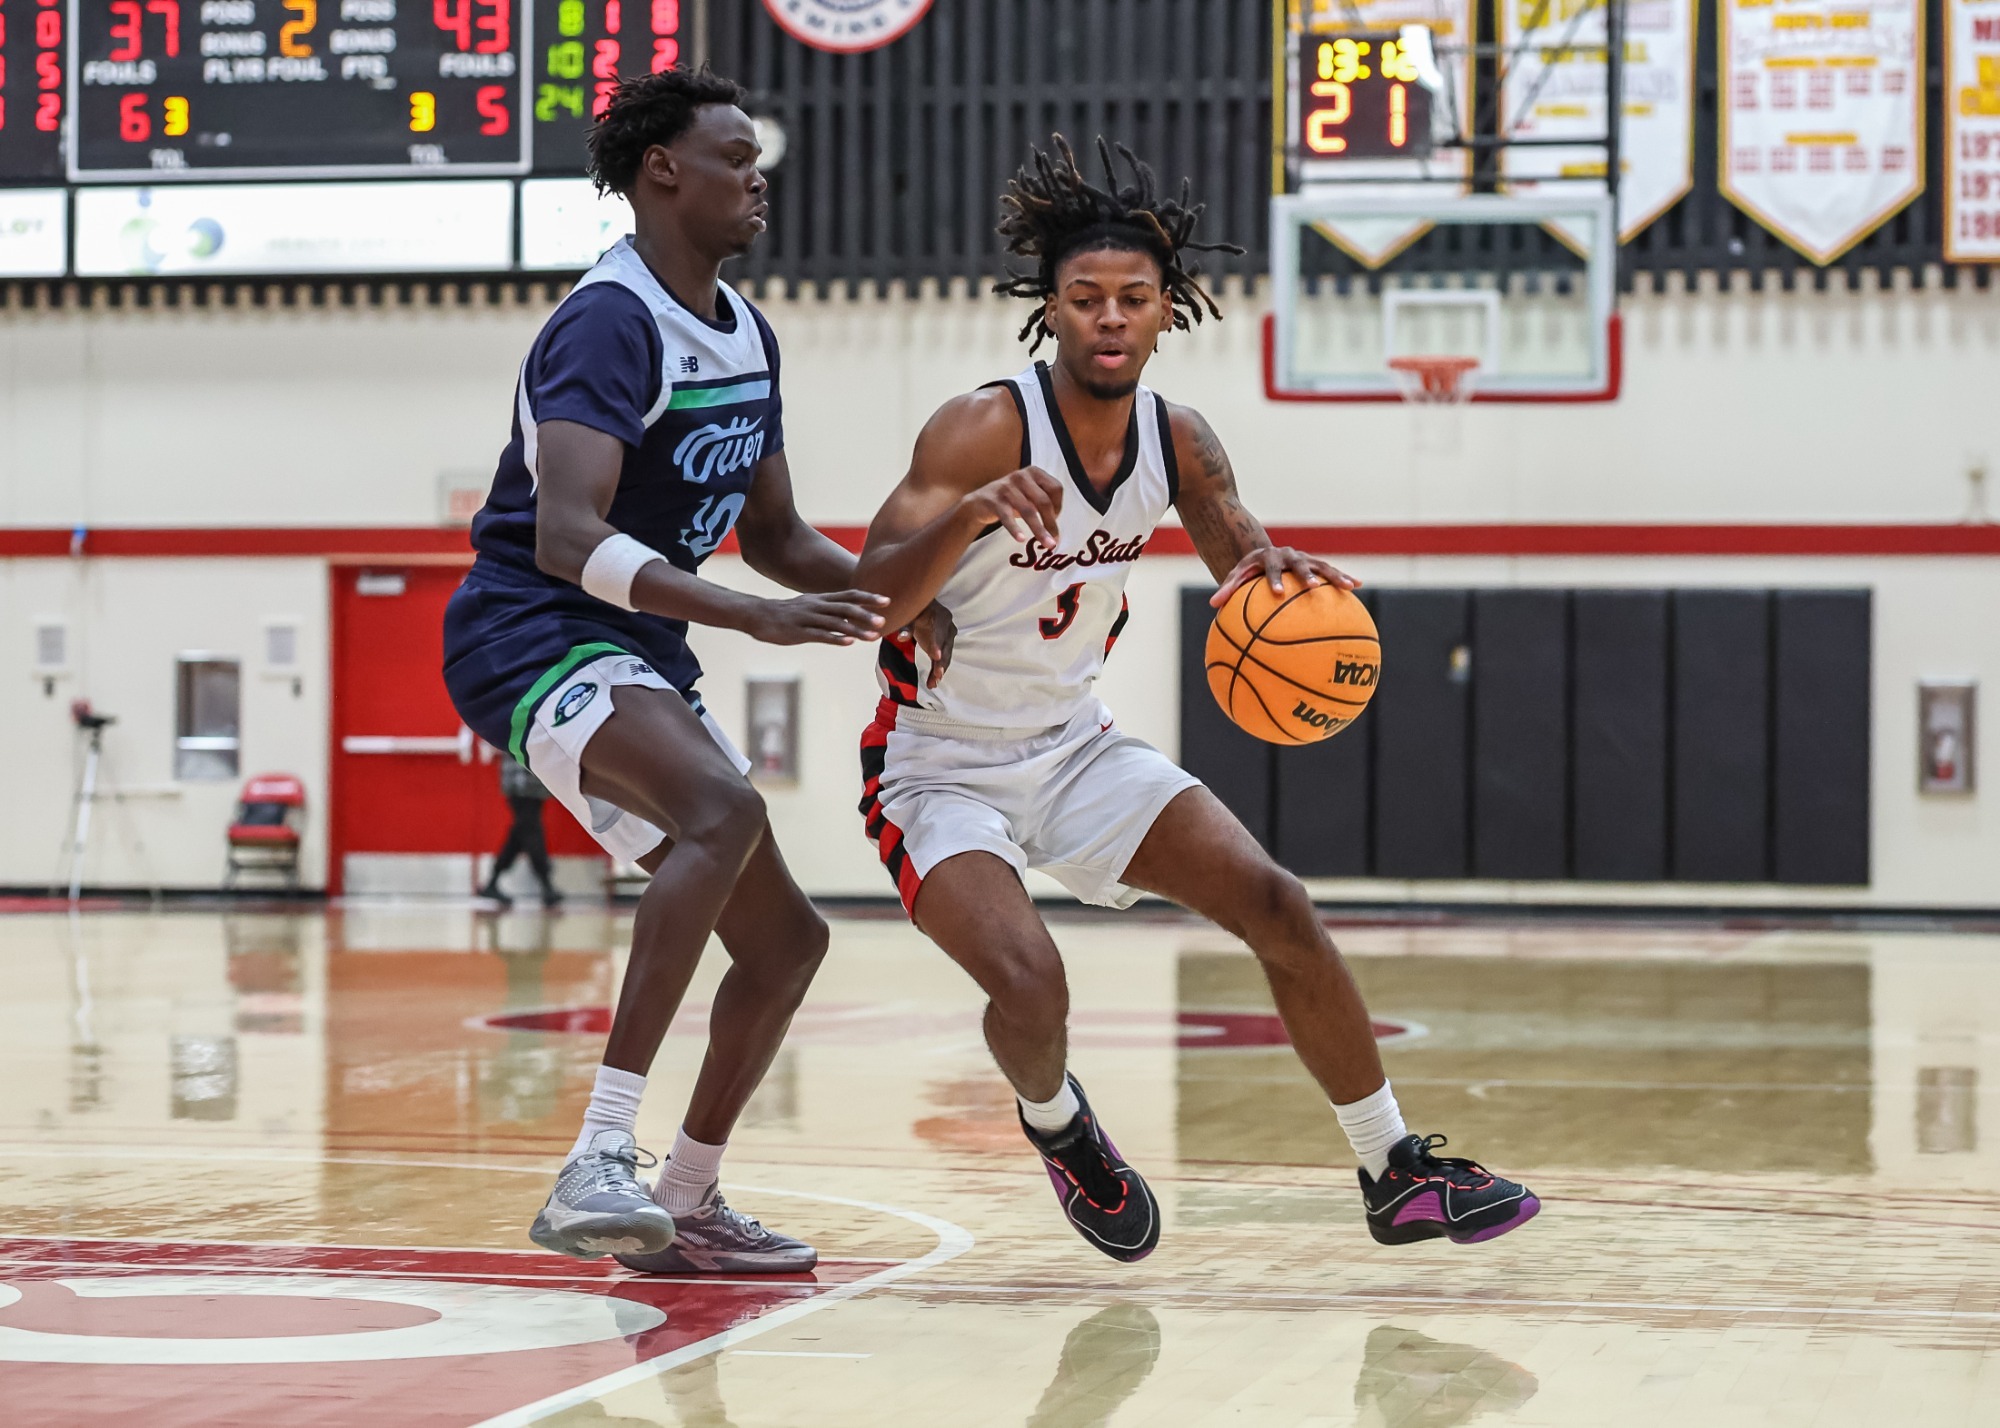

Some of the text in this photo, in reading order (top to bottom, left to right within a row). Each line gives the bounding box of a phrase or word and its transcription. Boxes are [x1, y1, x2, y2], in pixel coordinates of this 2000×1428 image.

[109, 0, 180, 62] 37
[279, 0, 317, 58] 2
[433, 0, 511, 53] 43
[36, 52, 61, 89] 5
[83, 60, 157, 85] FOULS
[203, 57, 328, 83] PLYR FOUL
[439, 52, 516, 77] FOULS
[593, 39, 621, 79] 2
[35, 93, 61, 131] 2
[119, 93, 151, 142] 6
[163, 96, 189, 136] 3
[409, 92, 436, 132] 3
[476, 85, 509, 136] 5
[535, 83, 584, 122] 24
